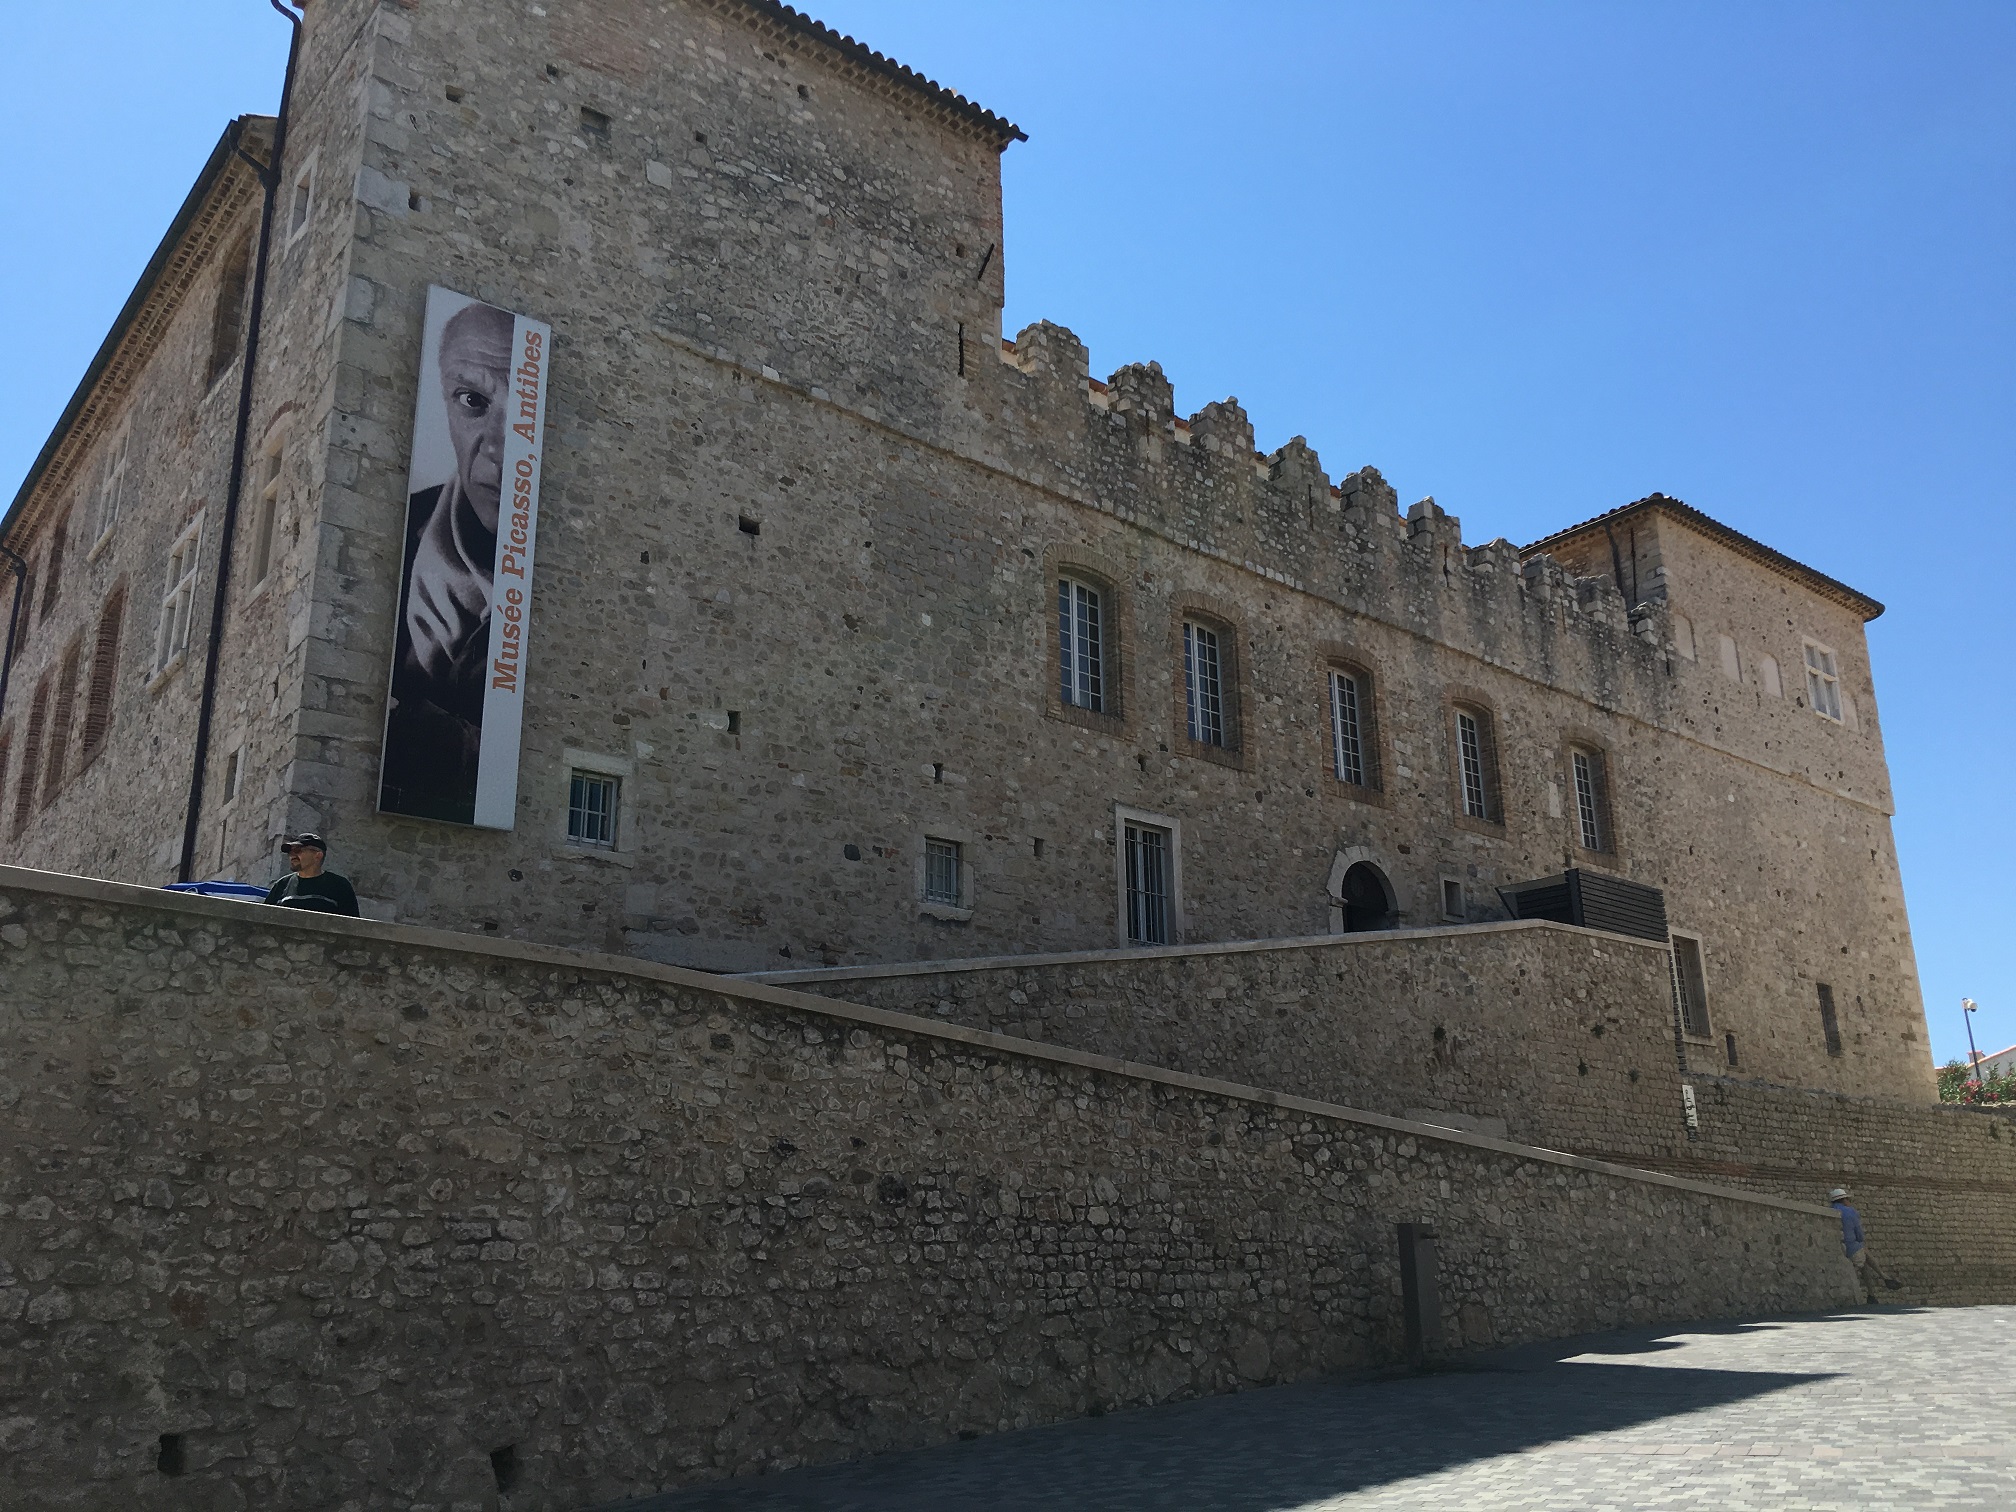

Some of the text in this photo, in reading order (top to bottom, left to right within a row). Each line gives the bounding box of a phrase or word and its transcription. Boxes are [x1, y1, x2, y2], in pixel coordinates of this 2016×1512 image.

[492, 330, 543, 694] Musée Picasso, Antibes
